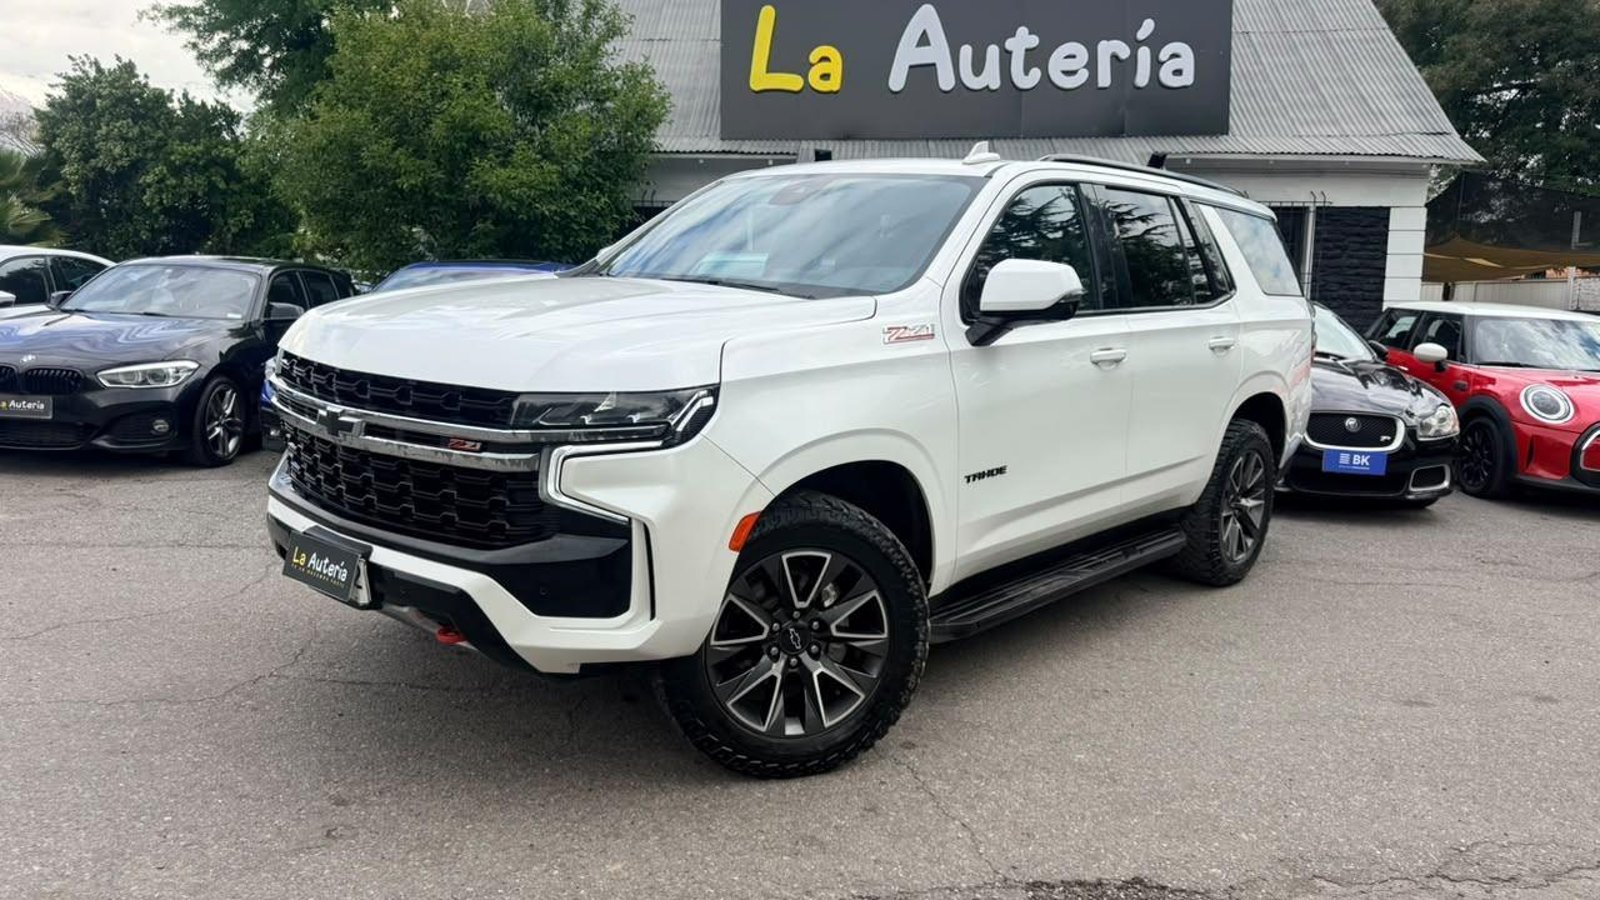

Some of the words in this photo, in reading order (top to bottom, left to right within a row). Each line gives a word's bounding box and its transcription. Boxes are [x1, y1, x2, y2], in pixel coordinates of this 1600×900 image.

[749, 4, 844, 93] La
[888, 3, 1195, 93] Autería
[964, 464, 1008, 484] TAHOE
[1352, 454, 1371, 466] BK
[292, 546, 307, 566] La
[307, 552, 348, 582] Autería
